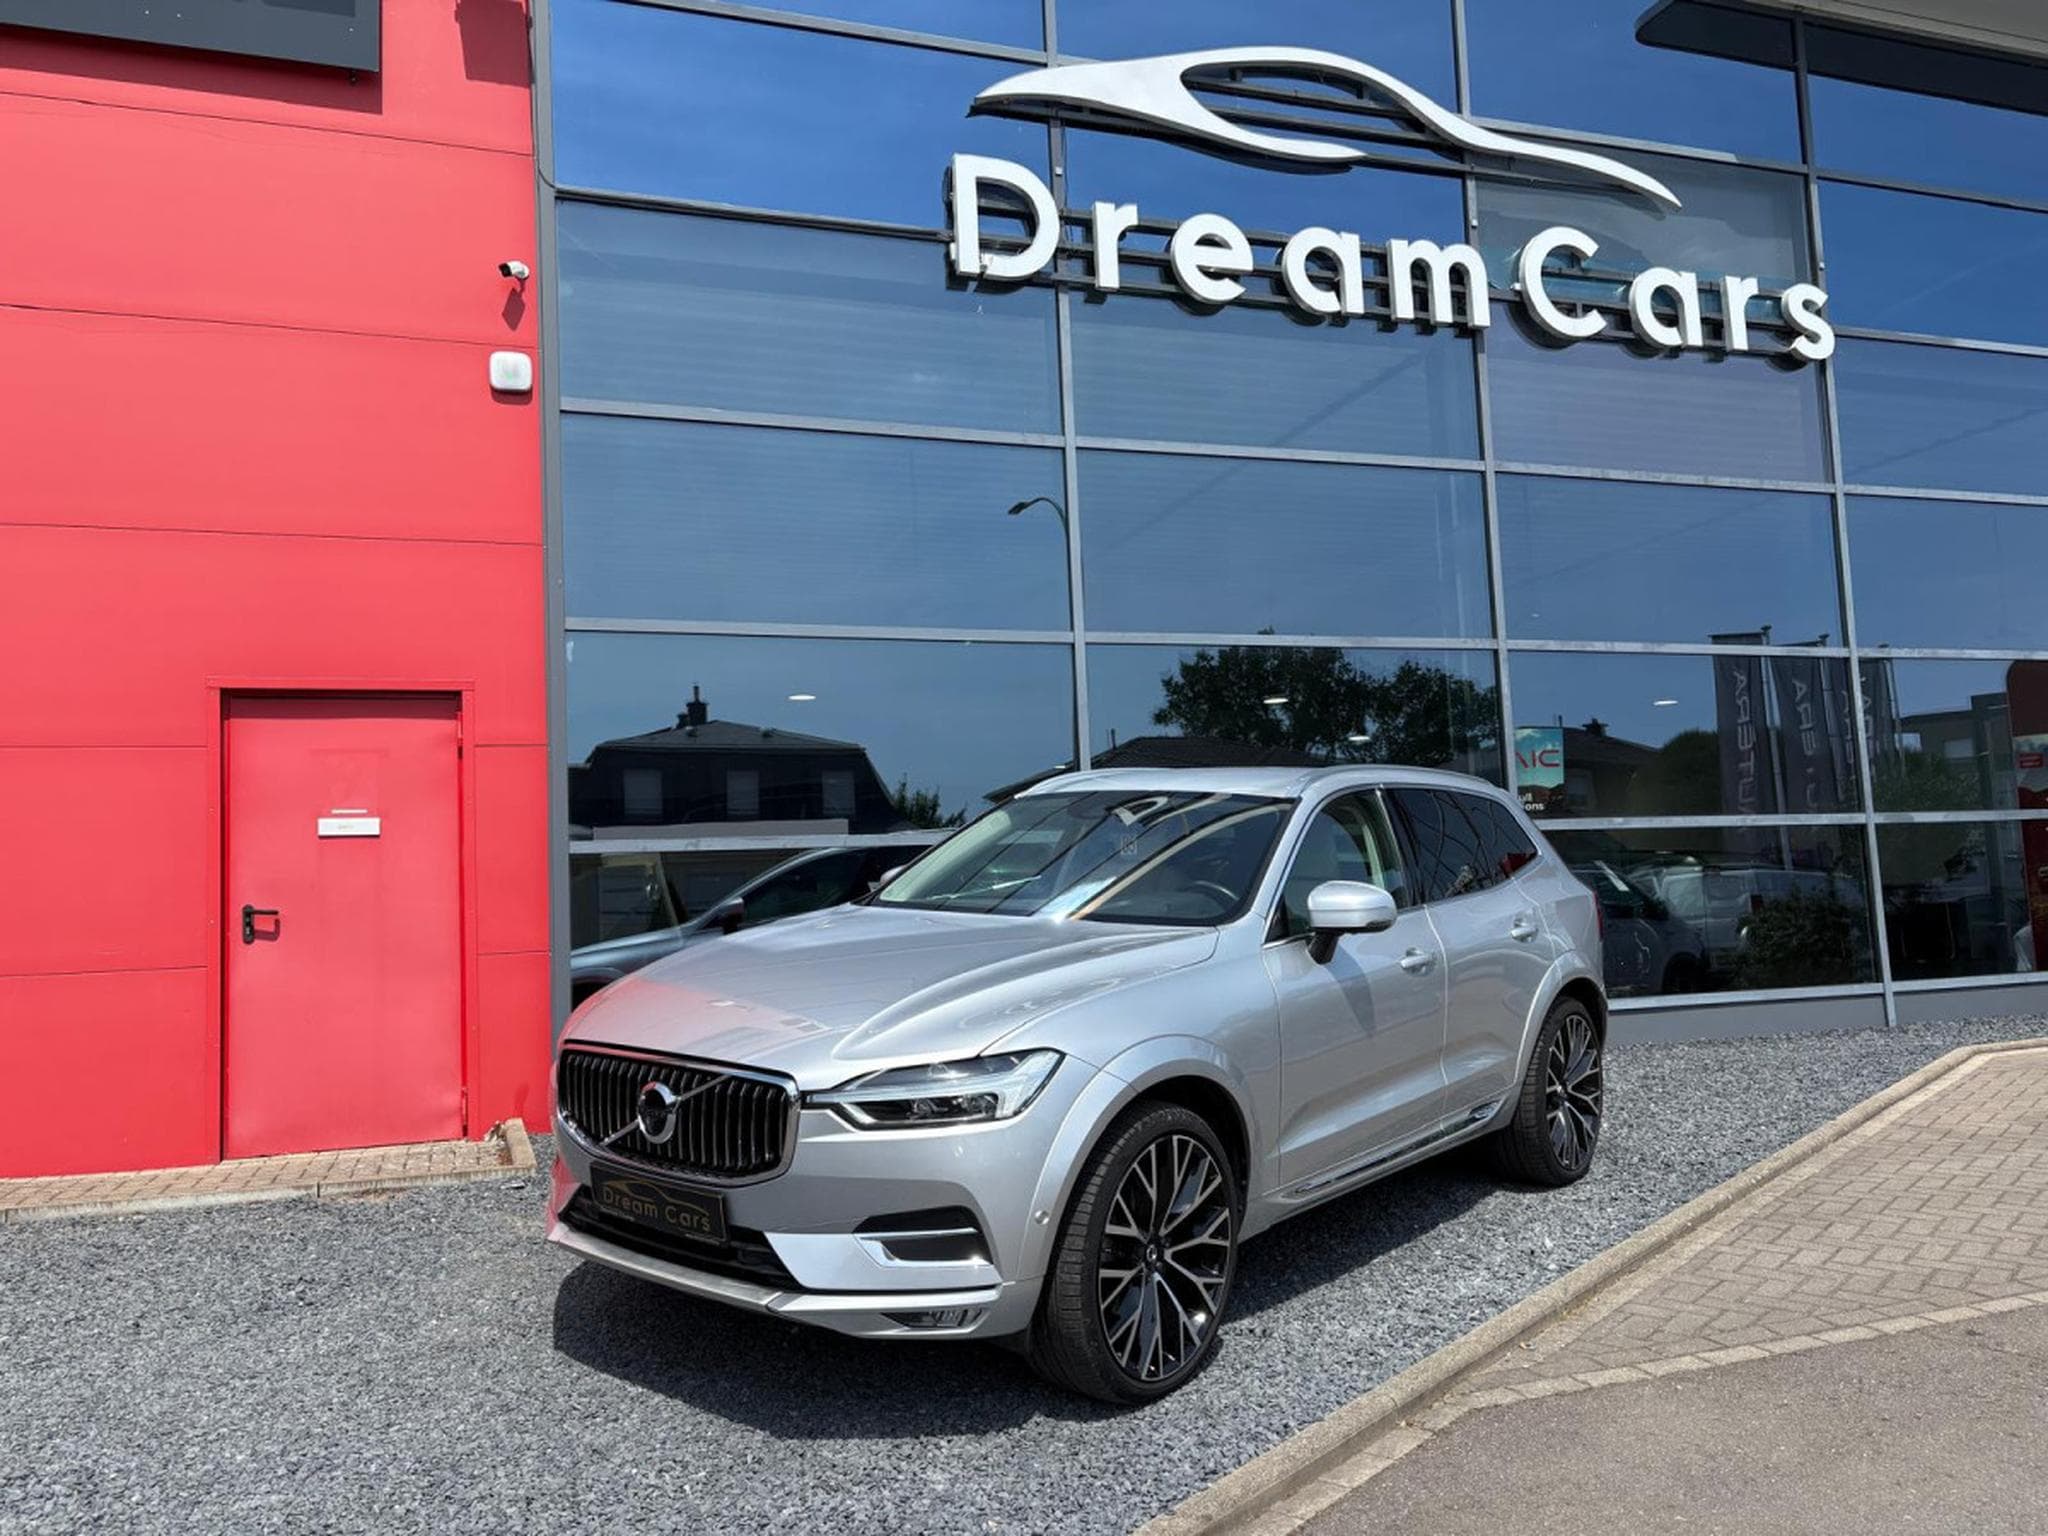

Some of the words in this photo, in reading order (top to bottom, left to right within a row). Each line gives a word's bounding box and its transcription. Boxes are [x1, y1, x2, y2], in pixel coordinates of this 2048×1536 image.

[951, 153, 1490, 328] Dream
[1518, 225, 1836, 360] Cars
[602, 1185, 658, 1218] Dream
[664, 1205, 712, 1233] Cars
